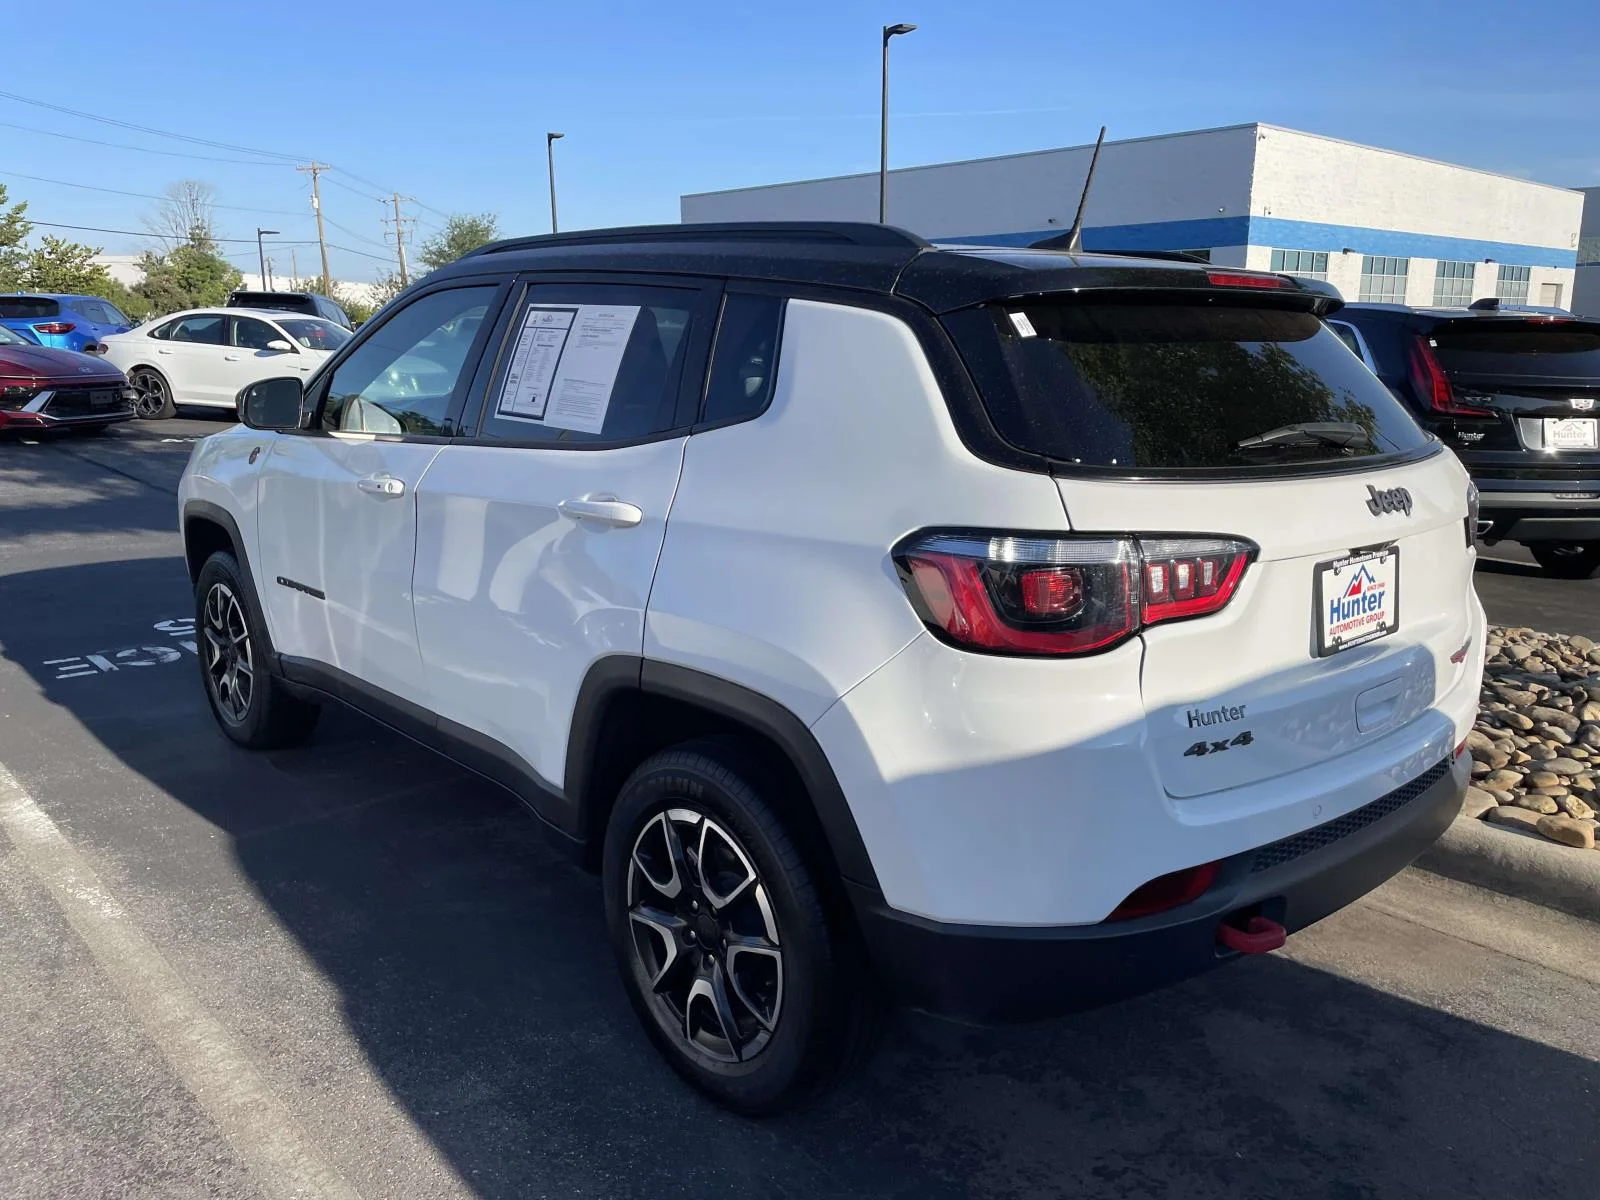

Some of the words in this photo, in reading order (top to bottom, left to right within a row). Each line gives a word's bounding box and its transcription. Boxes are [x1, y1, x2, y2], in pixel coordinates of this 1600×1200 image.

[1553, 430, 1588, 439] Hunter
[1365, 484, 1413, 517] Jeep
[1329, 590, 1386, 625] Hunter
[1329, 617, 1365, 637] AUTOMOTIVE
[1366, 611, 1385, 625] GROUP
[1186, 704, 1247, 728] Hunter
[1183, 730, 1254, 757] 4x4
